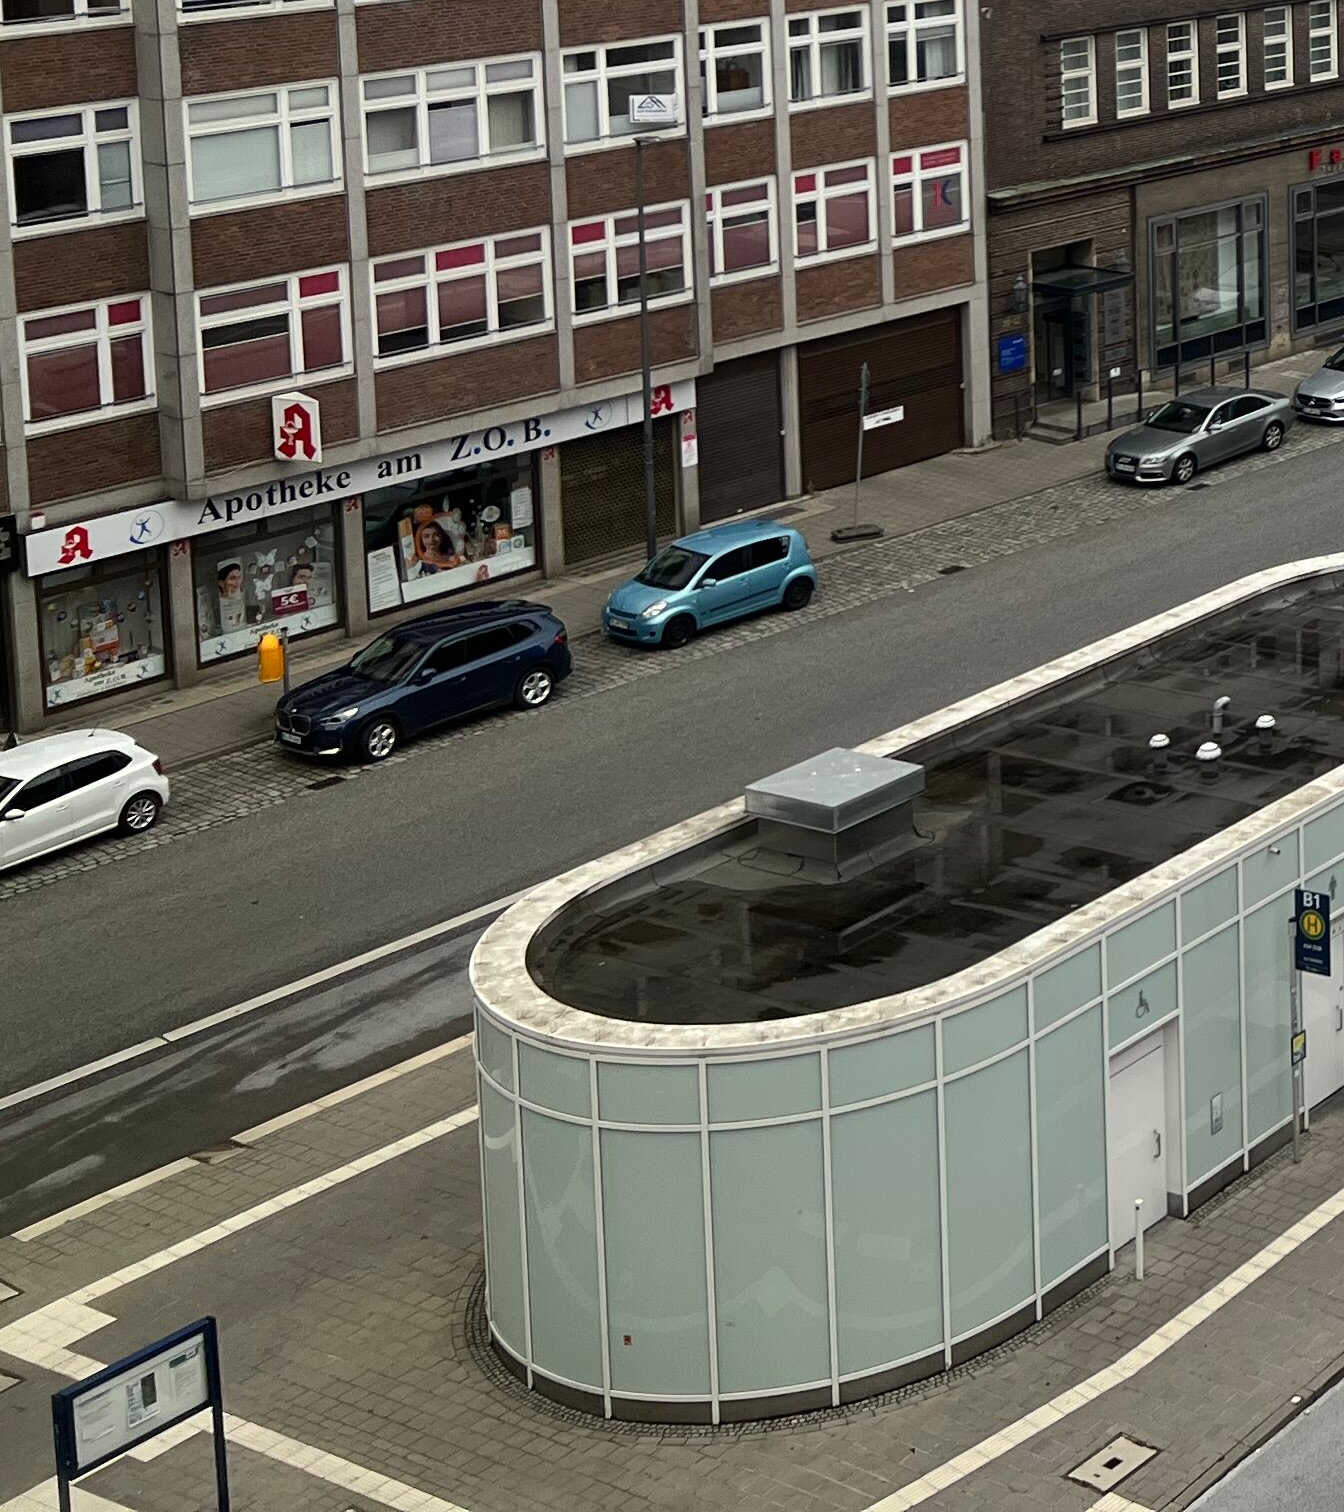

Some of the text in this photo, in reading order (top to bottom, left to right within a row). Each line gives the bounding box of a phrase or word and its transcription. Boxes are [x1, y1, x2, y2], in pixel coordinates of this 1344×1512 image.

[277, 403, 316, 460] A
[197, 470, 351, 525] Apotheke
[377, 453, 422, 479] am
[57, 526, 94, 565] A
[1303, 891, 1320, 910] B1
